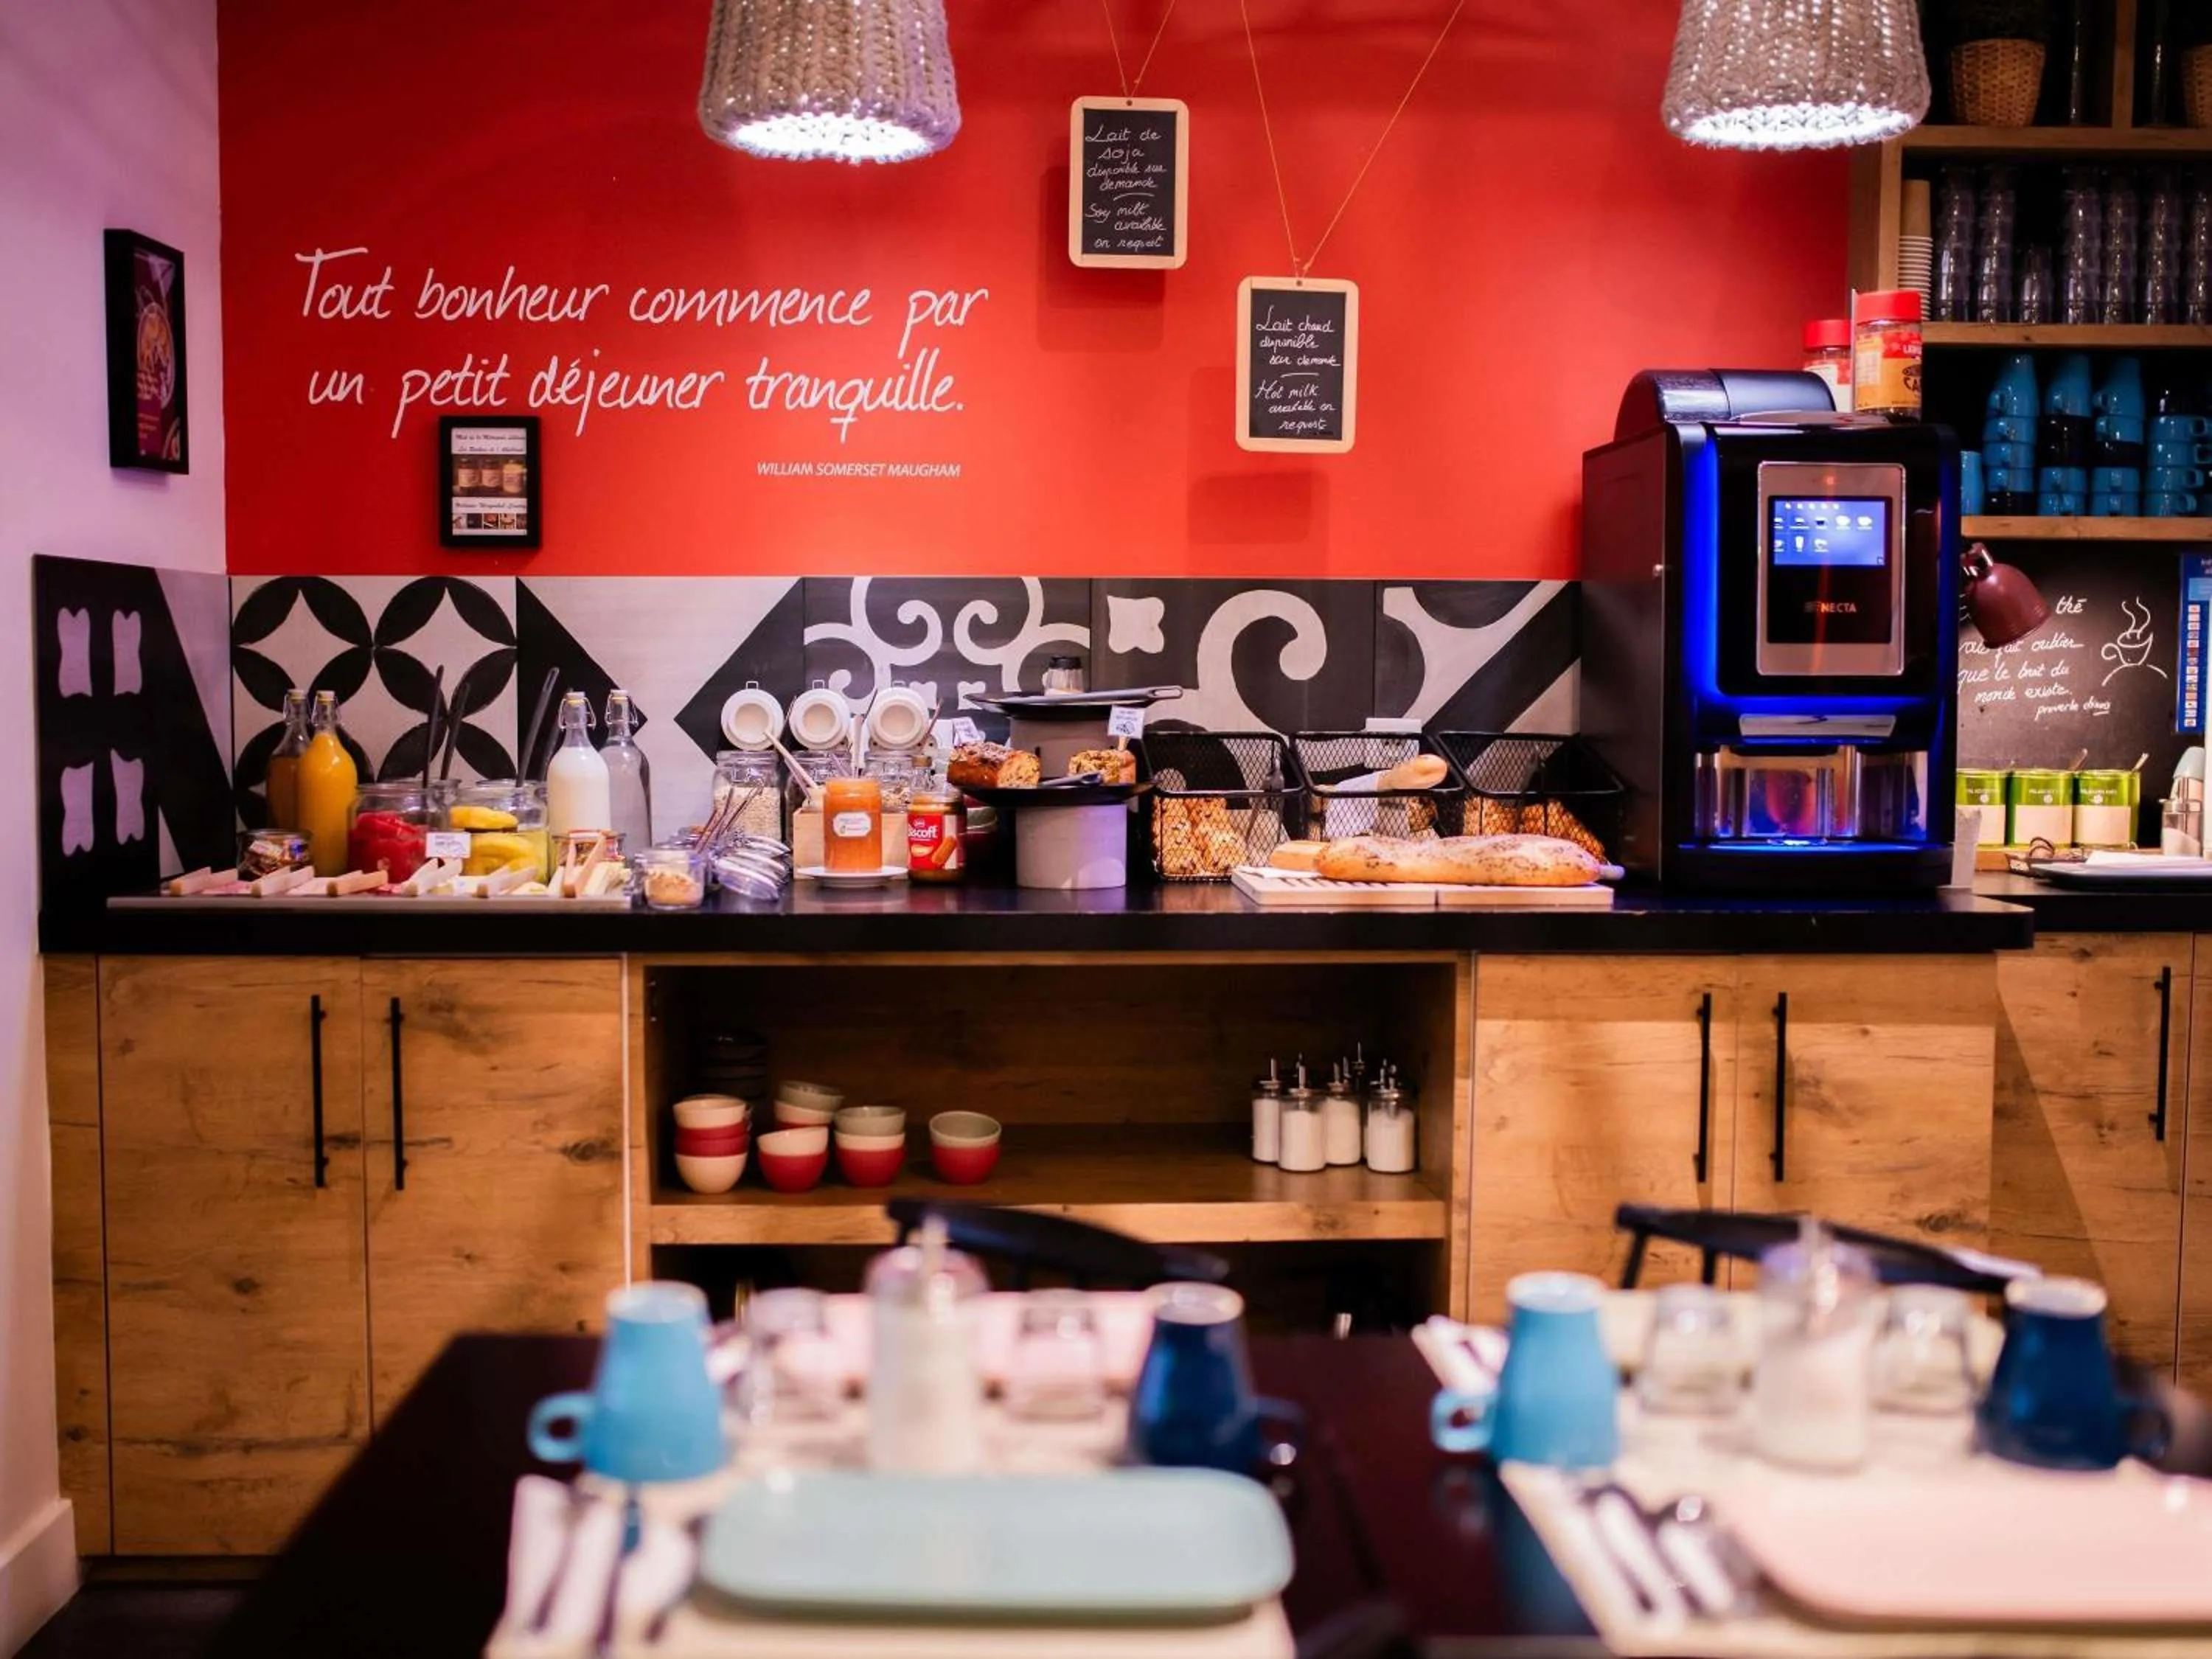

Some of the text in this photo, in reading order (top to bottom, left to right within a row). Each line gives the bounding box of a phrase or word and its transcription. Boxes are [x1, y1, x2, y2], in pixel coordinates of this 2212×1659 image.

[1085, 124, 1162, 142] Lait de
[1098, 145, 1145, 164] soja
[1087, 162, 1167, 178] disponible sur
[1099, 178, 1157, 191] demande
[1085, 203, 1149, 223] Soy milk
[1114, 217, 1166, 231] available
[1094, 237, 1110, 249] on
[294, 247, 989, 360] Tout bonheur commence par
[1256, 305, 1335, 333] Lait chaud
[1259, 333, 1319, 352] disponible
[1269, 354, 1290, 365] sur
[307, 347, 964, 444] un petit déjeuner tranquille.
[1255, 379, 1319, 400] Hot milk
[1268, 400, 1337, 414] available on
[1279, 419, 1327, 434] request
[757, 462, 961, 478] WILLIAM SOMERSET MAUGHAM
[1820, 602, 1857, 613] NECTA
[2055, 595, 2087, 615] thé
[2031, 632, 2085, 651] oublier
[1957, 669, 1990, 695] que
[1994, 661, 2011, 681] le
[2051, 660, 2070, 678] du
[1974, 686, 2016, 703] monde
[2034, 699, 2079, 722] proverbe
